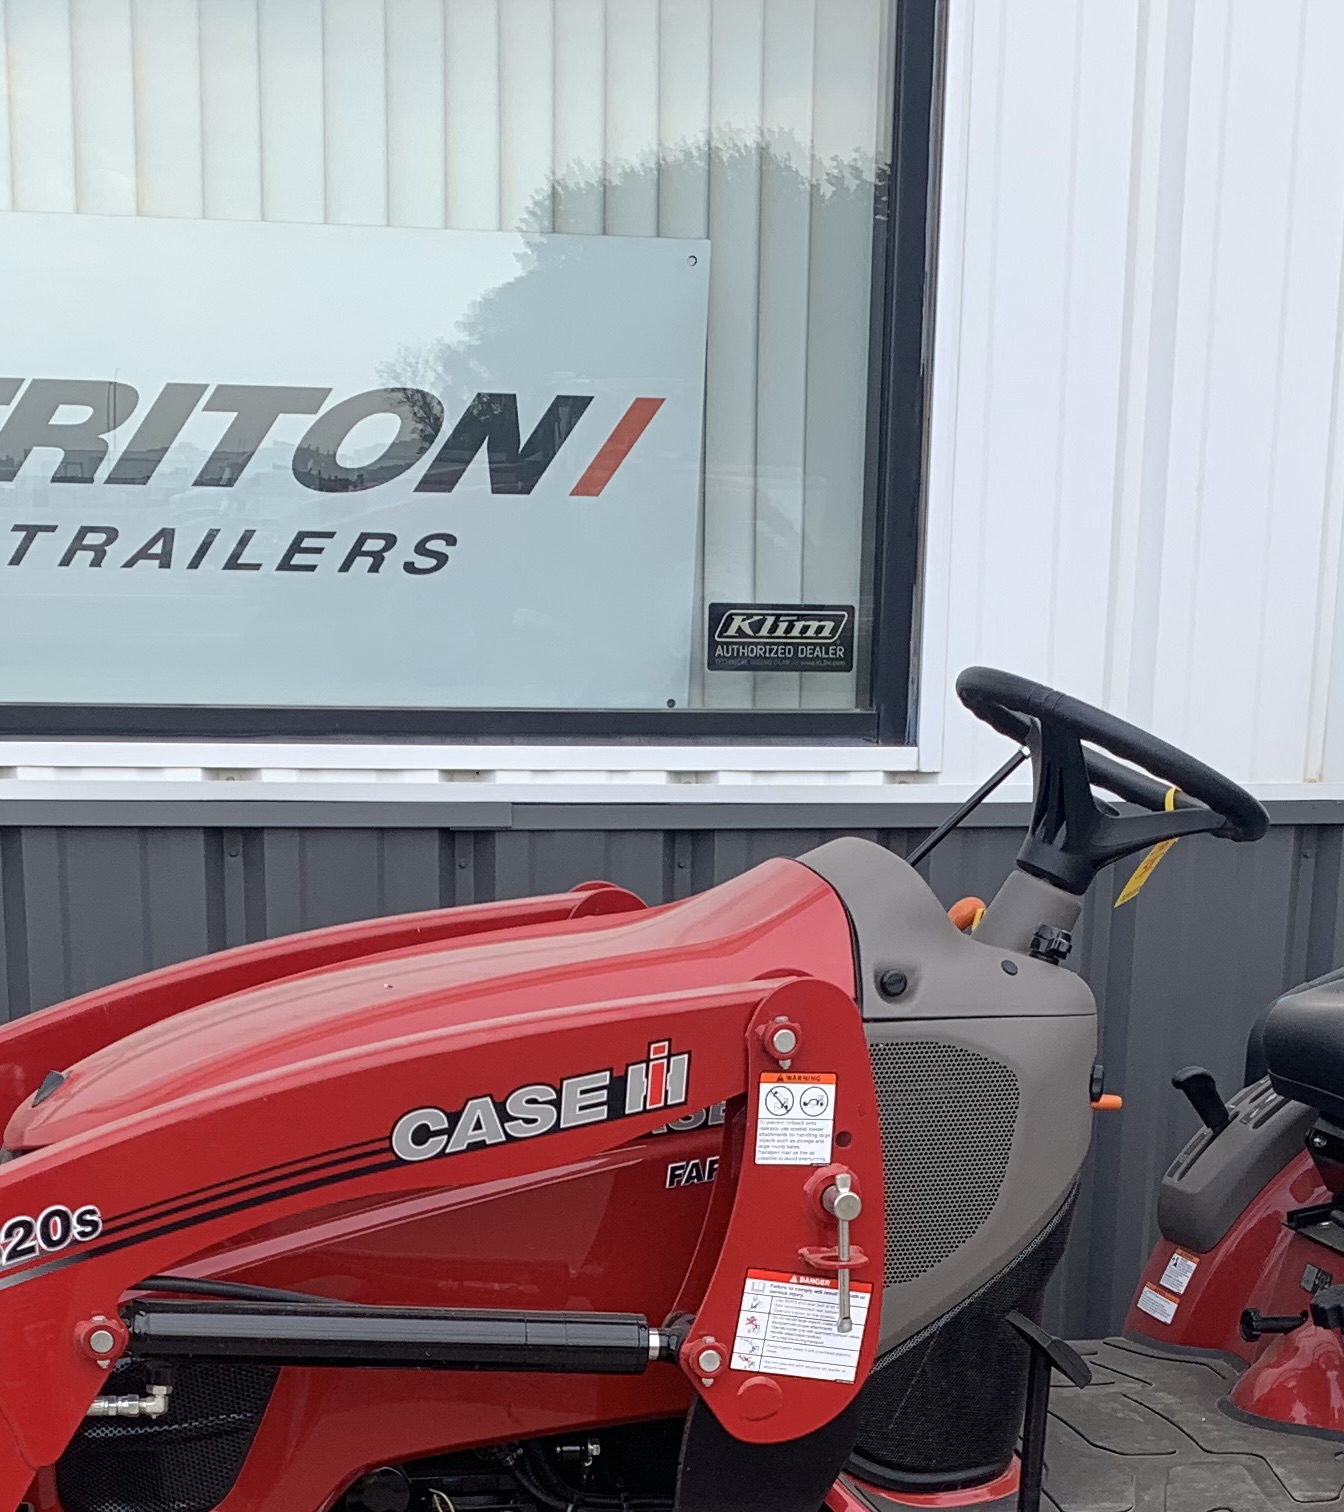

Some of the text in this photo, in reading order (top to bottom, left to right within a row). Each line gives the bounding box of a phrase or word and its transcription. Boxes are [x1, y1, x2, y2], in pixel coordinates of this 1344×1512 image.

[7, 524, 458, 576] TRAILERS
[715, 645, 844, 658] AUTHORIZED DEALER
[391, 1069, 611, 1162] CASE
[799, 1276, 830, 1286] DANGER
